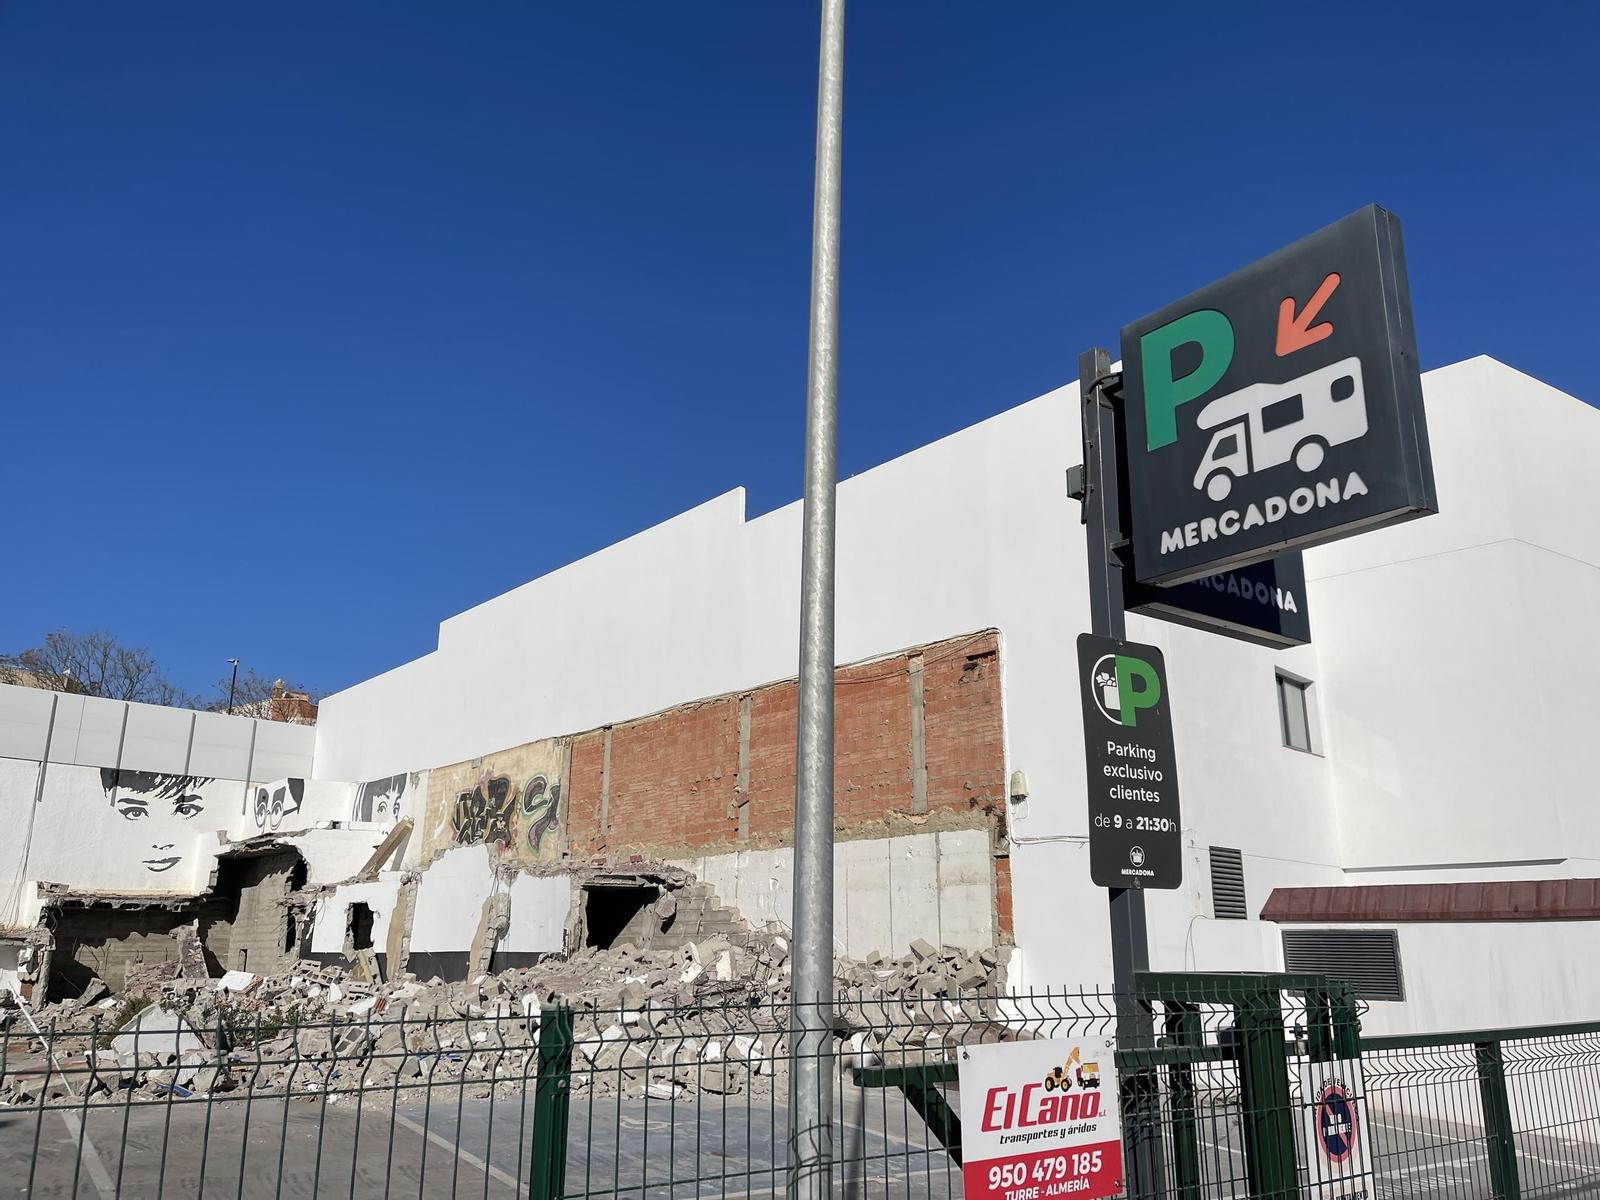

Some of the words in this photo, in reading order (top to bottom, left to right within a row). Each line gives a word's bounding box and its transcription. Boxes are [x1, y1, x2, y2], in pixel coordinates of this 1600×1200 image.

[1141, 309, 1235, 452] P
[1160, 471, 1369, 555] MERCADONA
[1115, 655, 1161, 727] P
[1107, 741, 1157, 763] Parking
[1103, 763, 1163, 782] exclusivo
[1109, 785, 1160, 803] clientes
[1094, 813, 1111, 829] de
[1113, 814, 1123, 829] 9
[1125, 817, 1133, 830] a
[1136, 815, 1177, 833] 21:30h
[1121, 868, 1155, 876] MERCADONA
[1000, 1126, 1058, 1145] transportes
[1060, 1128, 1066, 1139] y
[1067, 1122, 1097, 1135] áridos
[988, 1162, 1027, 1190] 950
[1032, 1155, 1067, 1182] 479
[1072, 1150, 1102, 1175] 185
[1005, 1185, 1040, 1200] TURRE
[1045, 1176, 1090, 1197] ALMERÍA
